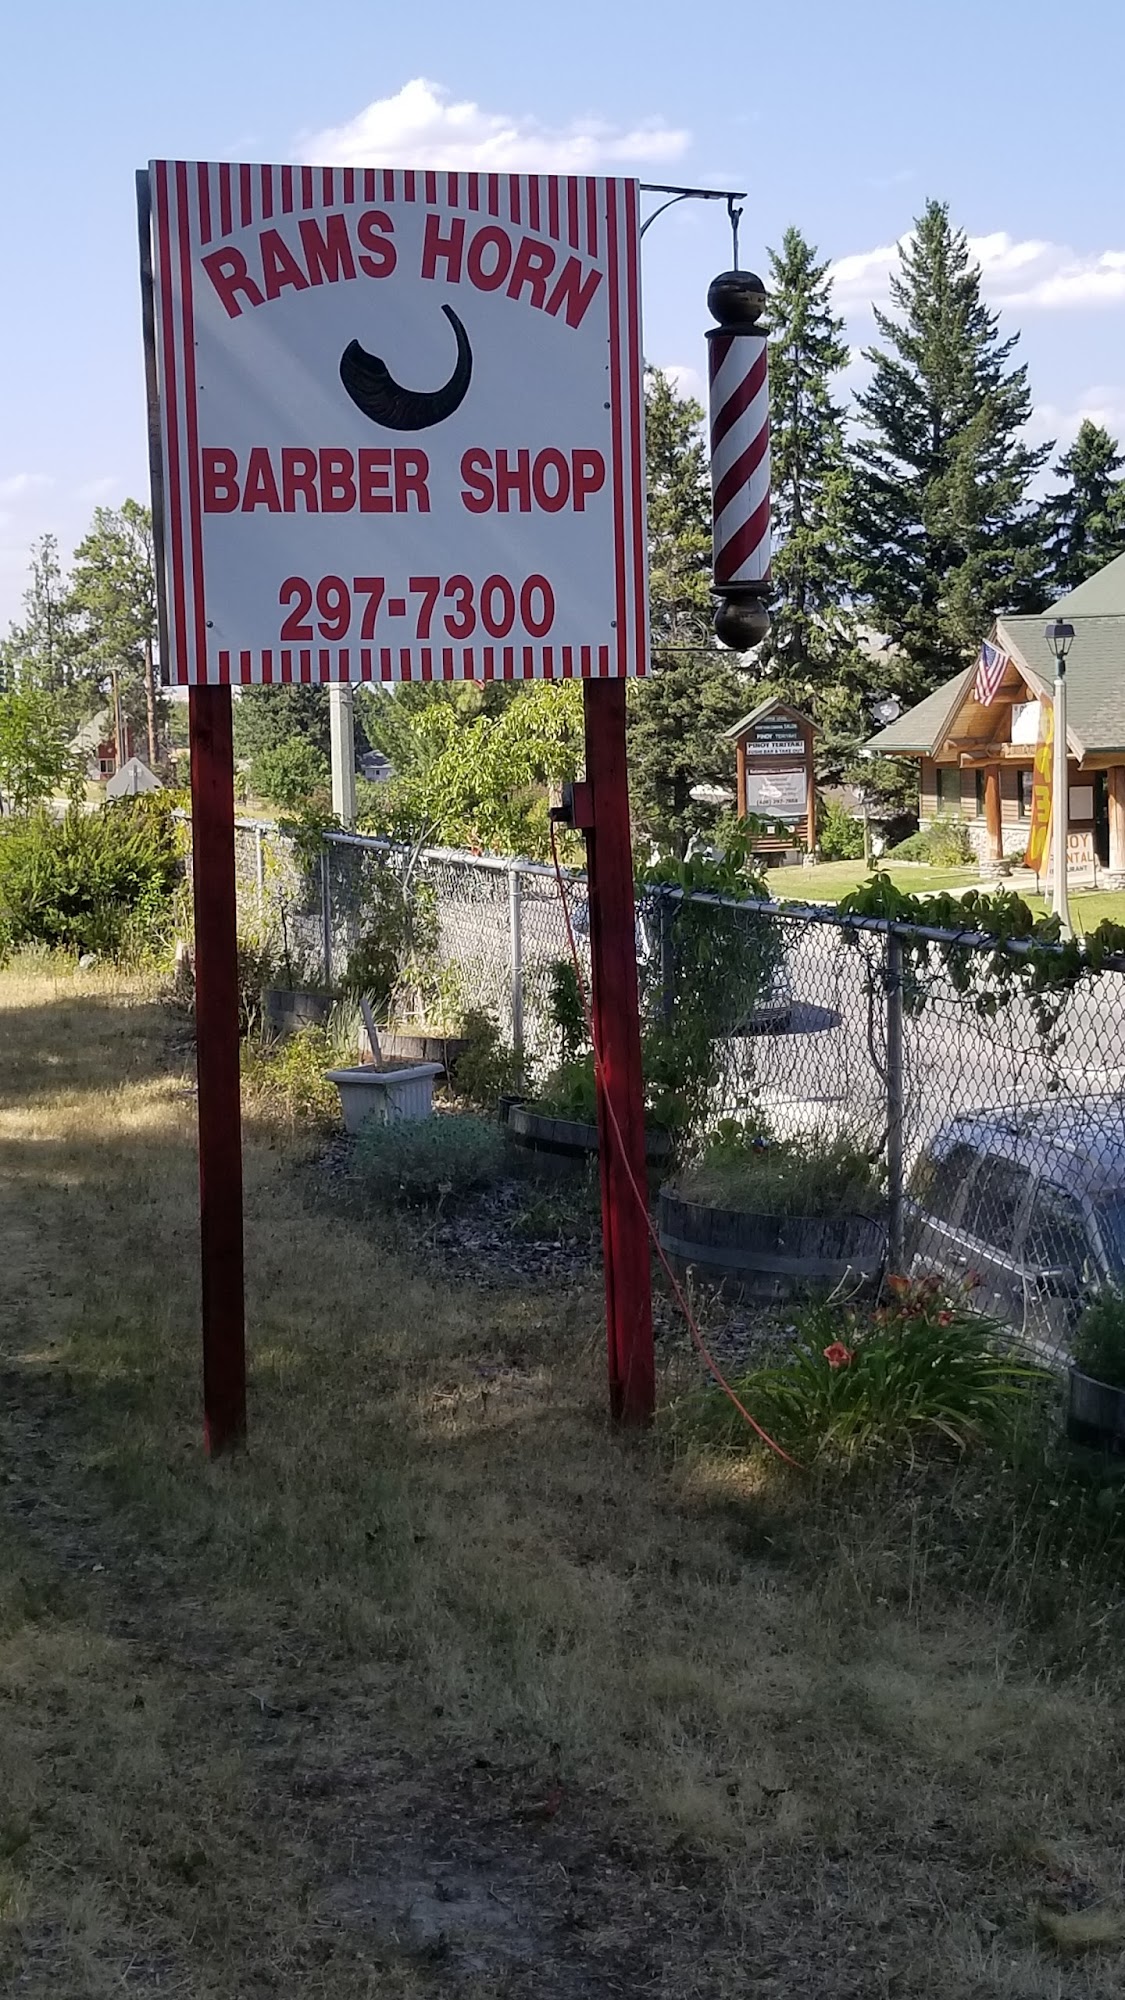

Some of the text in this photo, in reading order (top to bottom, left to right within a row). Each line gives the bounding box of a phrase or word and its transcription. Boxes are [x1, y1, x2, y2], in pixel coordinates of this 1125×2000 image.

[201, 210, 603, 330] RAMS HORN
[202, 447, 605, 513] BARBER SHOP
[279, 574, 555, 641] 297-7300
[1065, 851, 1094, 863] NTAL
[1069, 833, 1089, 848] OY
